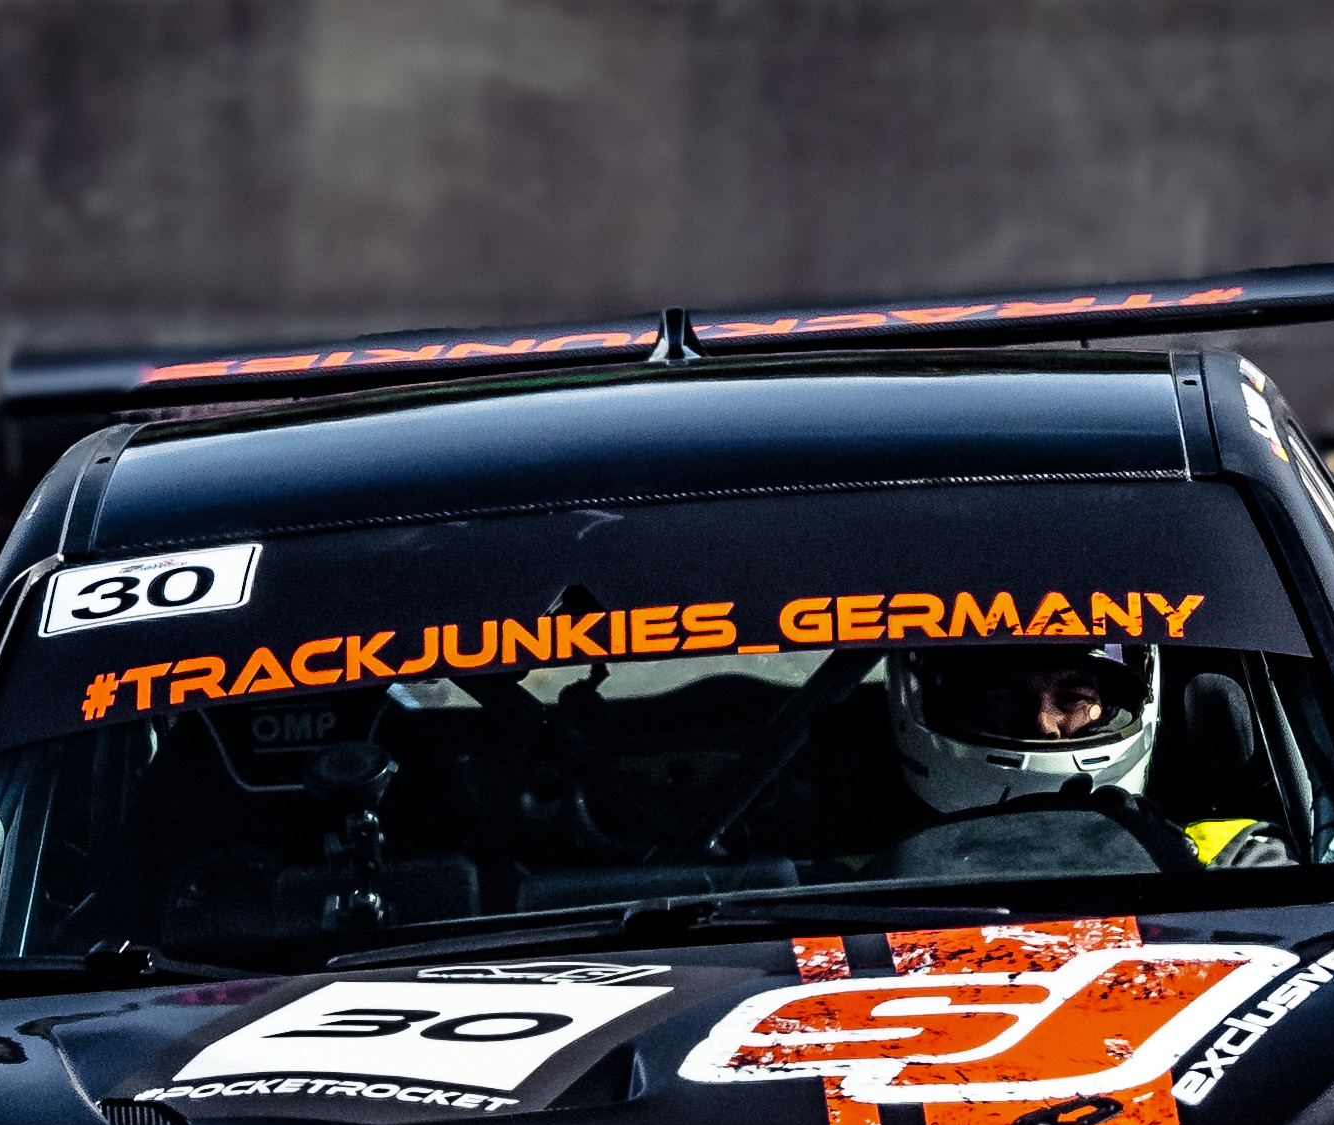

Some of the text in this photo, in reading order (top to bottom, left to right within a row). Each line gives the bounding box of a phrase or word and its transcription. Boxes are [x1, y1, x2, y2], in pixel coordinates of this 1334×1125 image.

[71, 565, 215, 620] 30
[81, 591, 1205, 722] #TRACKJUNKIES_GERMANY
[251, 709, 338, 742] OMP
[260, 1008, 574, 1042] 30
